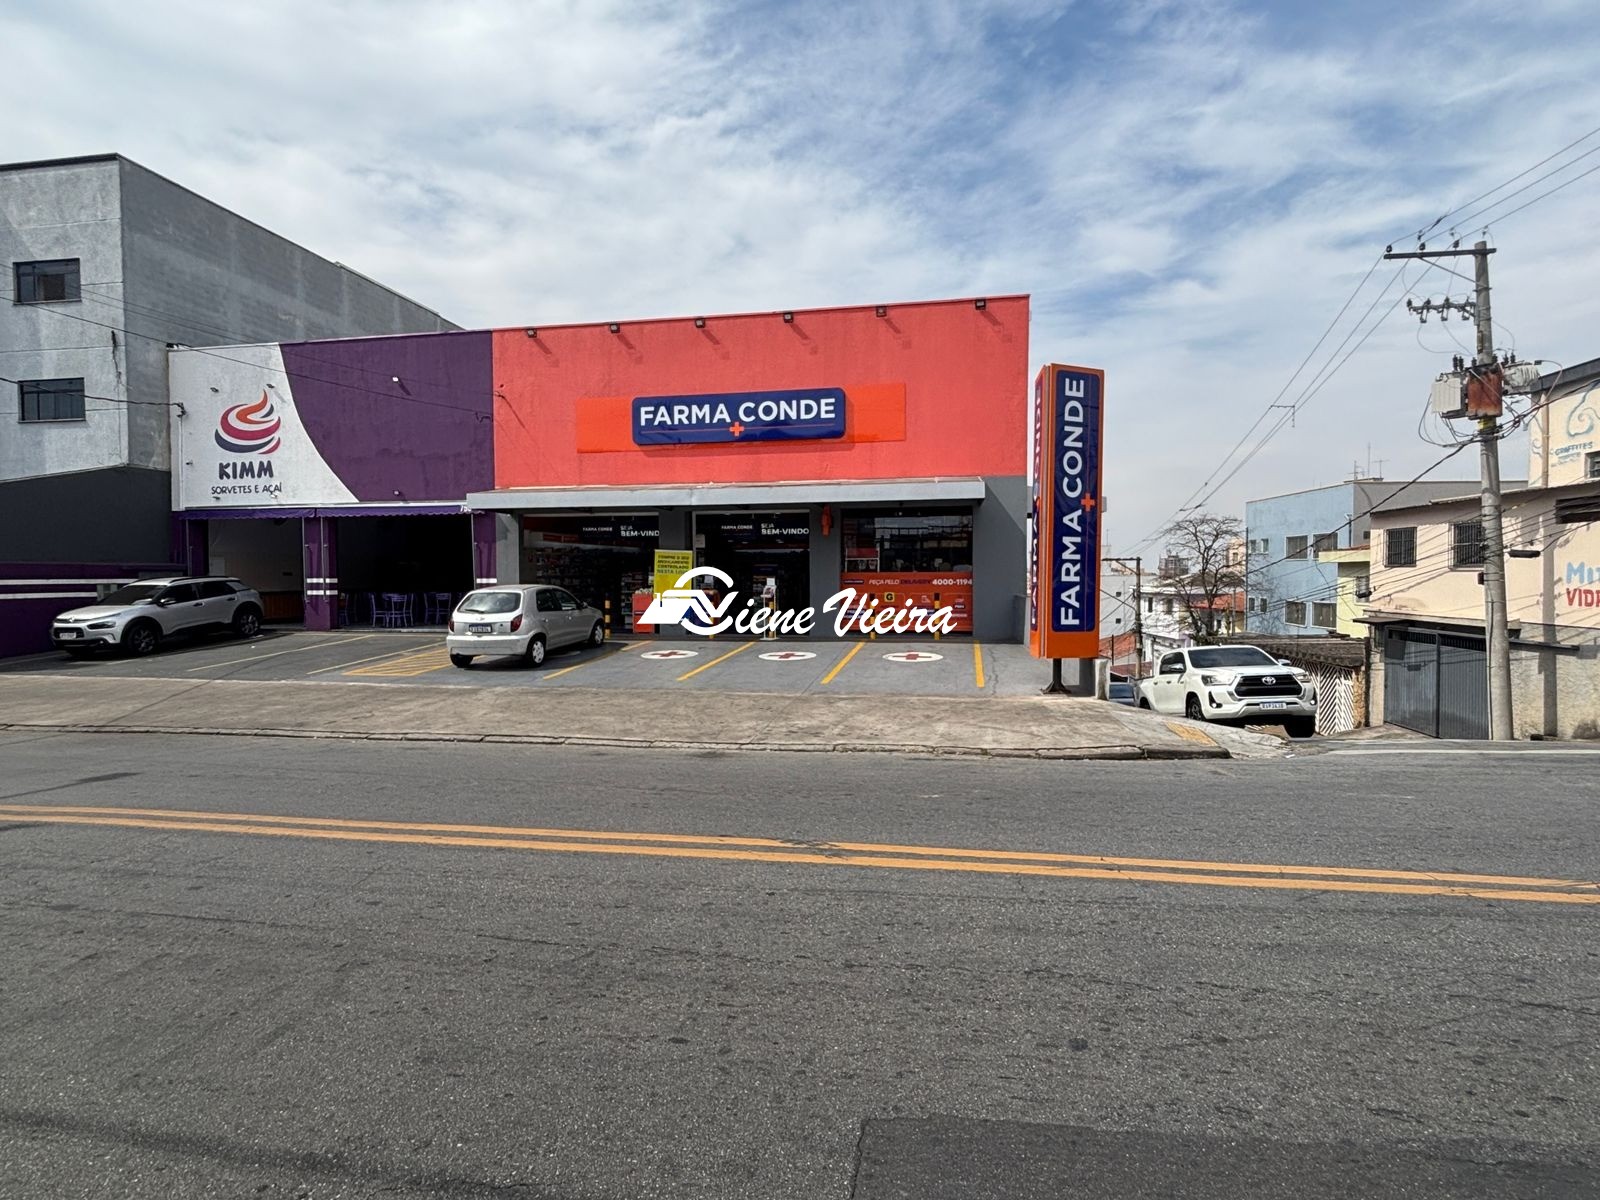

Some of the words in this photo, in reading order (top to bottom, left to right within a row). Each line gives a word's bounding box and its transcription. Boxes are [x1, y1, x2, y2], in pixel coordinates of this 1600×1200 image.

[640, 403, 731, 426] FARMA
[738, 398, 836, 422] CONDE
[1062, 377, 1085, 498] CONDE
[219, 460, 274, 480] KIMM
[211, 484, 252, 495] SORVETES
[254, 485, 260, 493] E
[262, 482, 282, 495] AÇAÍ
[1060, 509, 1083, 626] FARMA
